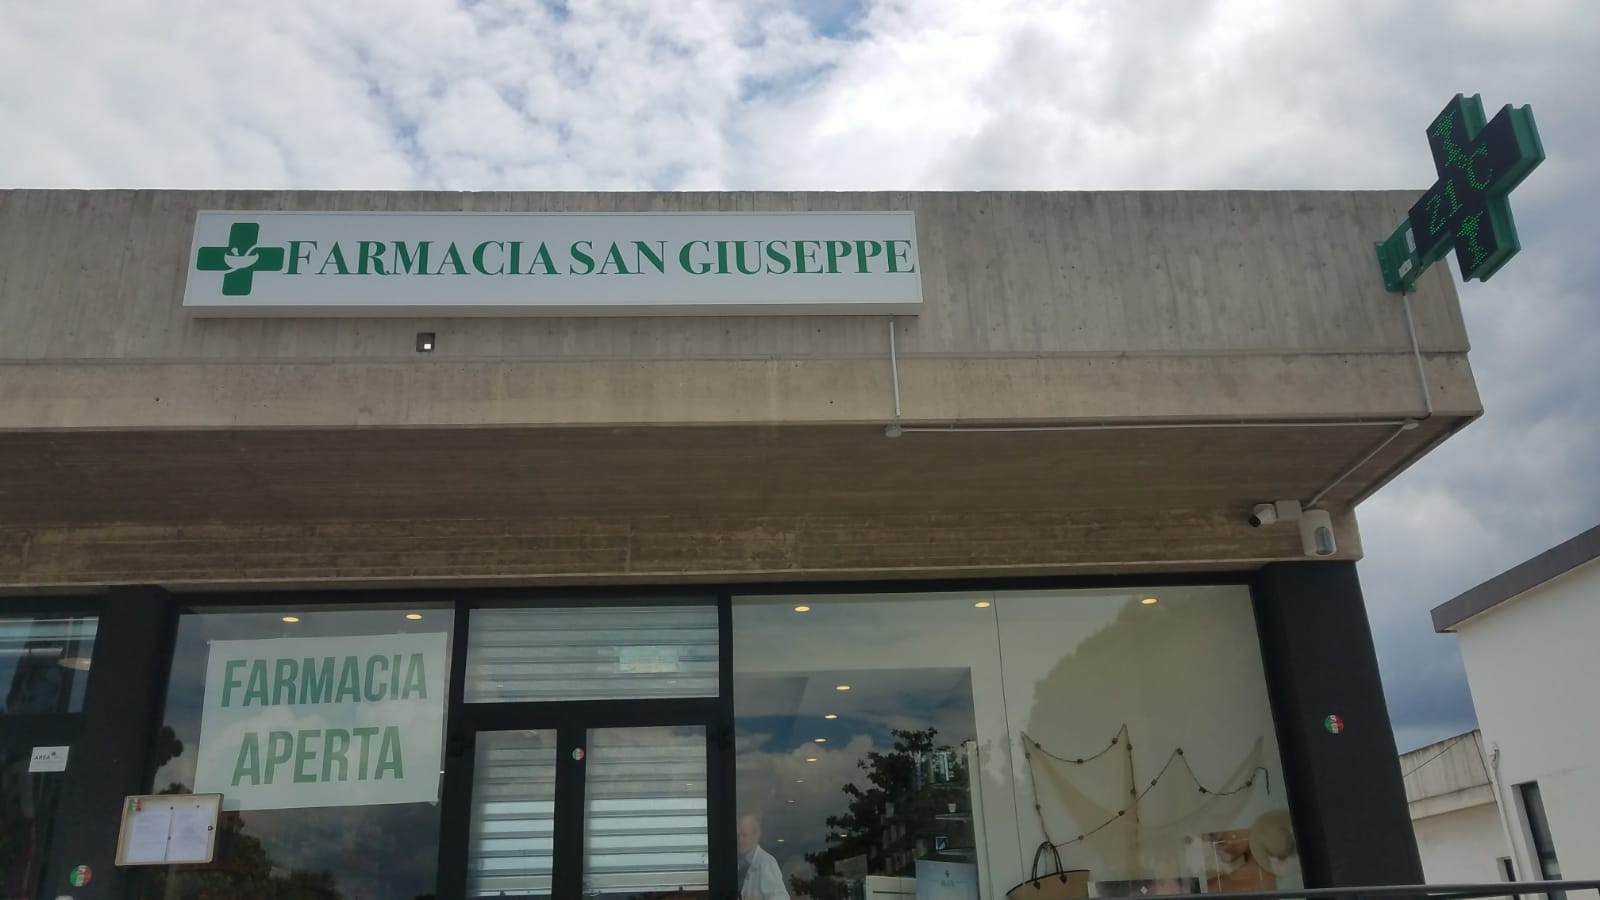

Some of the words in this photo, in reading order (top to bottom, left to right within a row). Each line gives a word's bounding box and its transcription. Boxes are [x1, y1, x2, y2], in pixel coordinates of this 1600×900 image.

[283, 240, 560, 276] FARMACIA
[569, 240, 668, 276] SAN
[678, 239, 914, 275] GIUSEPPE
[221, 653, 427, 707] FARMACIA
[231, 726, 404, 785] APERTA
